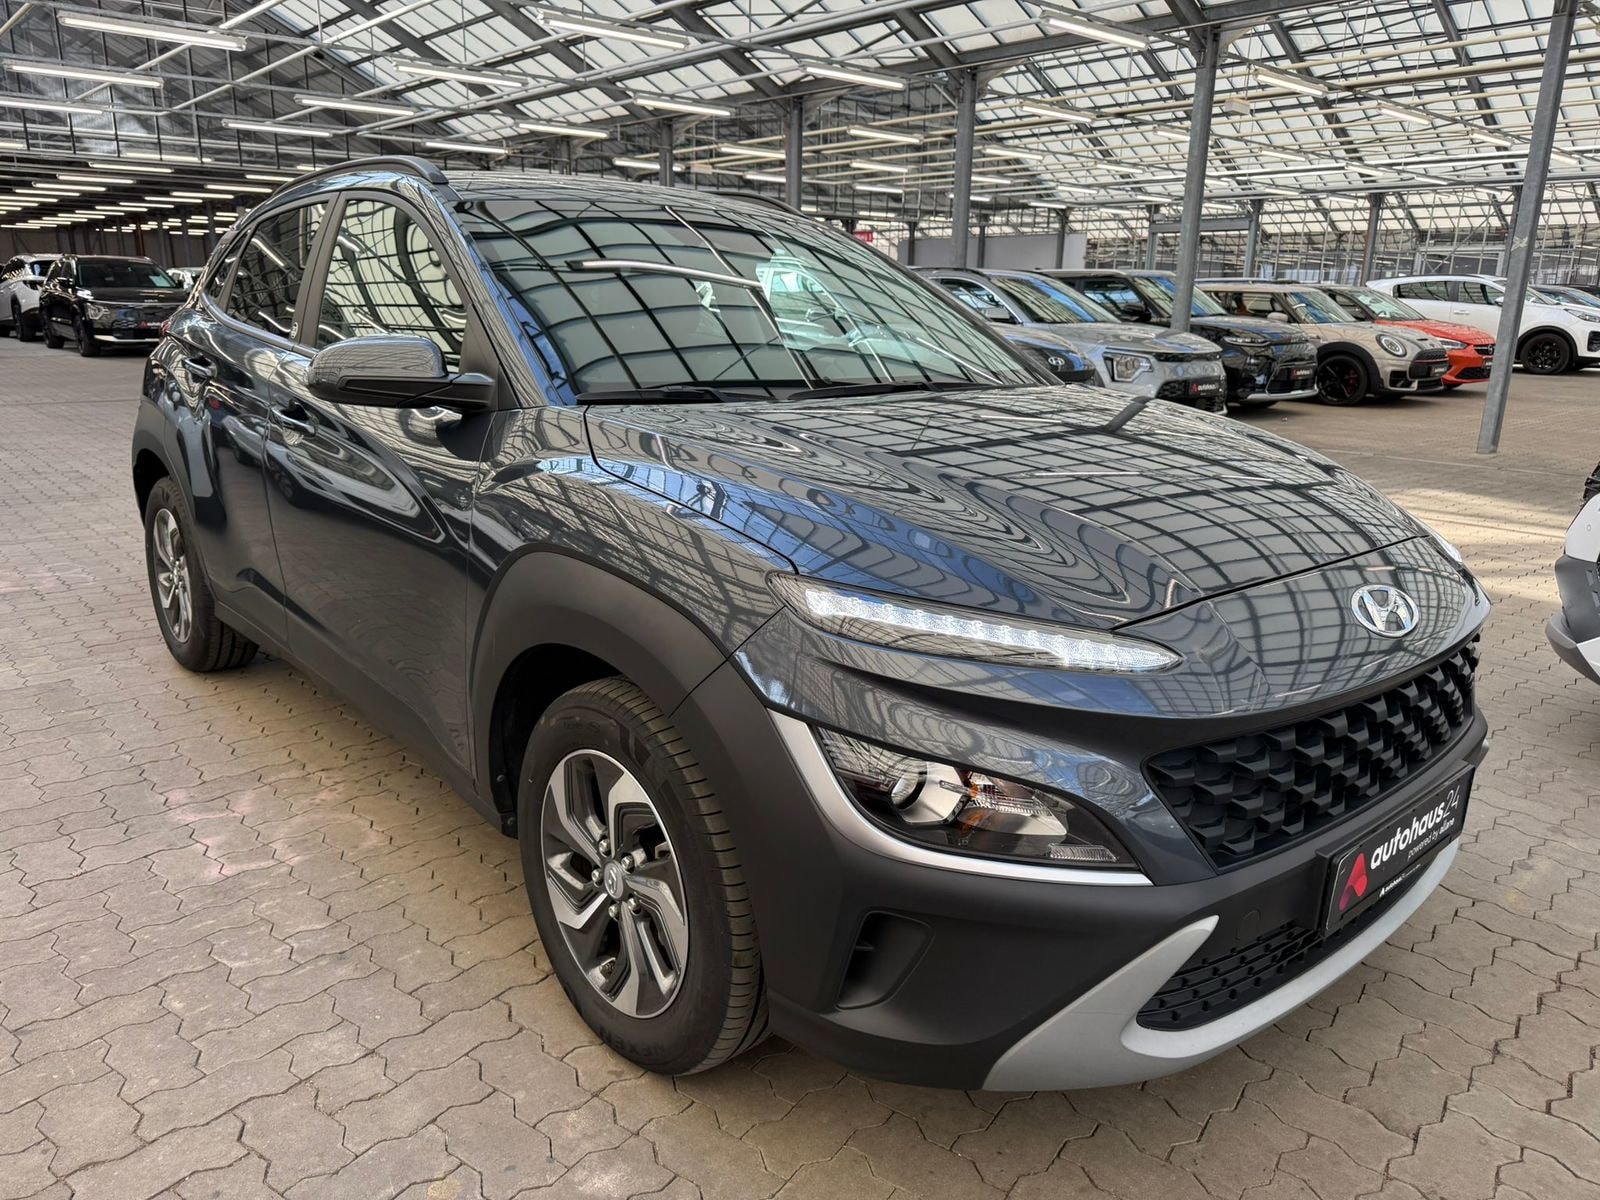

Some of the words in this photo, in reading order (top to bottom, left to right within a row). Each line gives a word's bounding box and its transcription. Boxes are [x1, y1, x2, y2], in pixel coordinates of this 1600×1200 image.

[1370, 785, 1460, 870] autohaus24
[1407, 834, 1432, 861] powered
[1431, 828, 1439, 841] by
